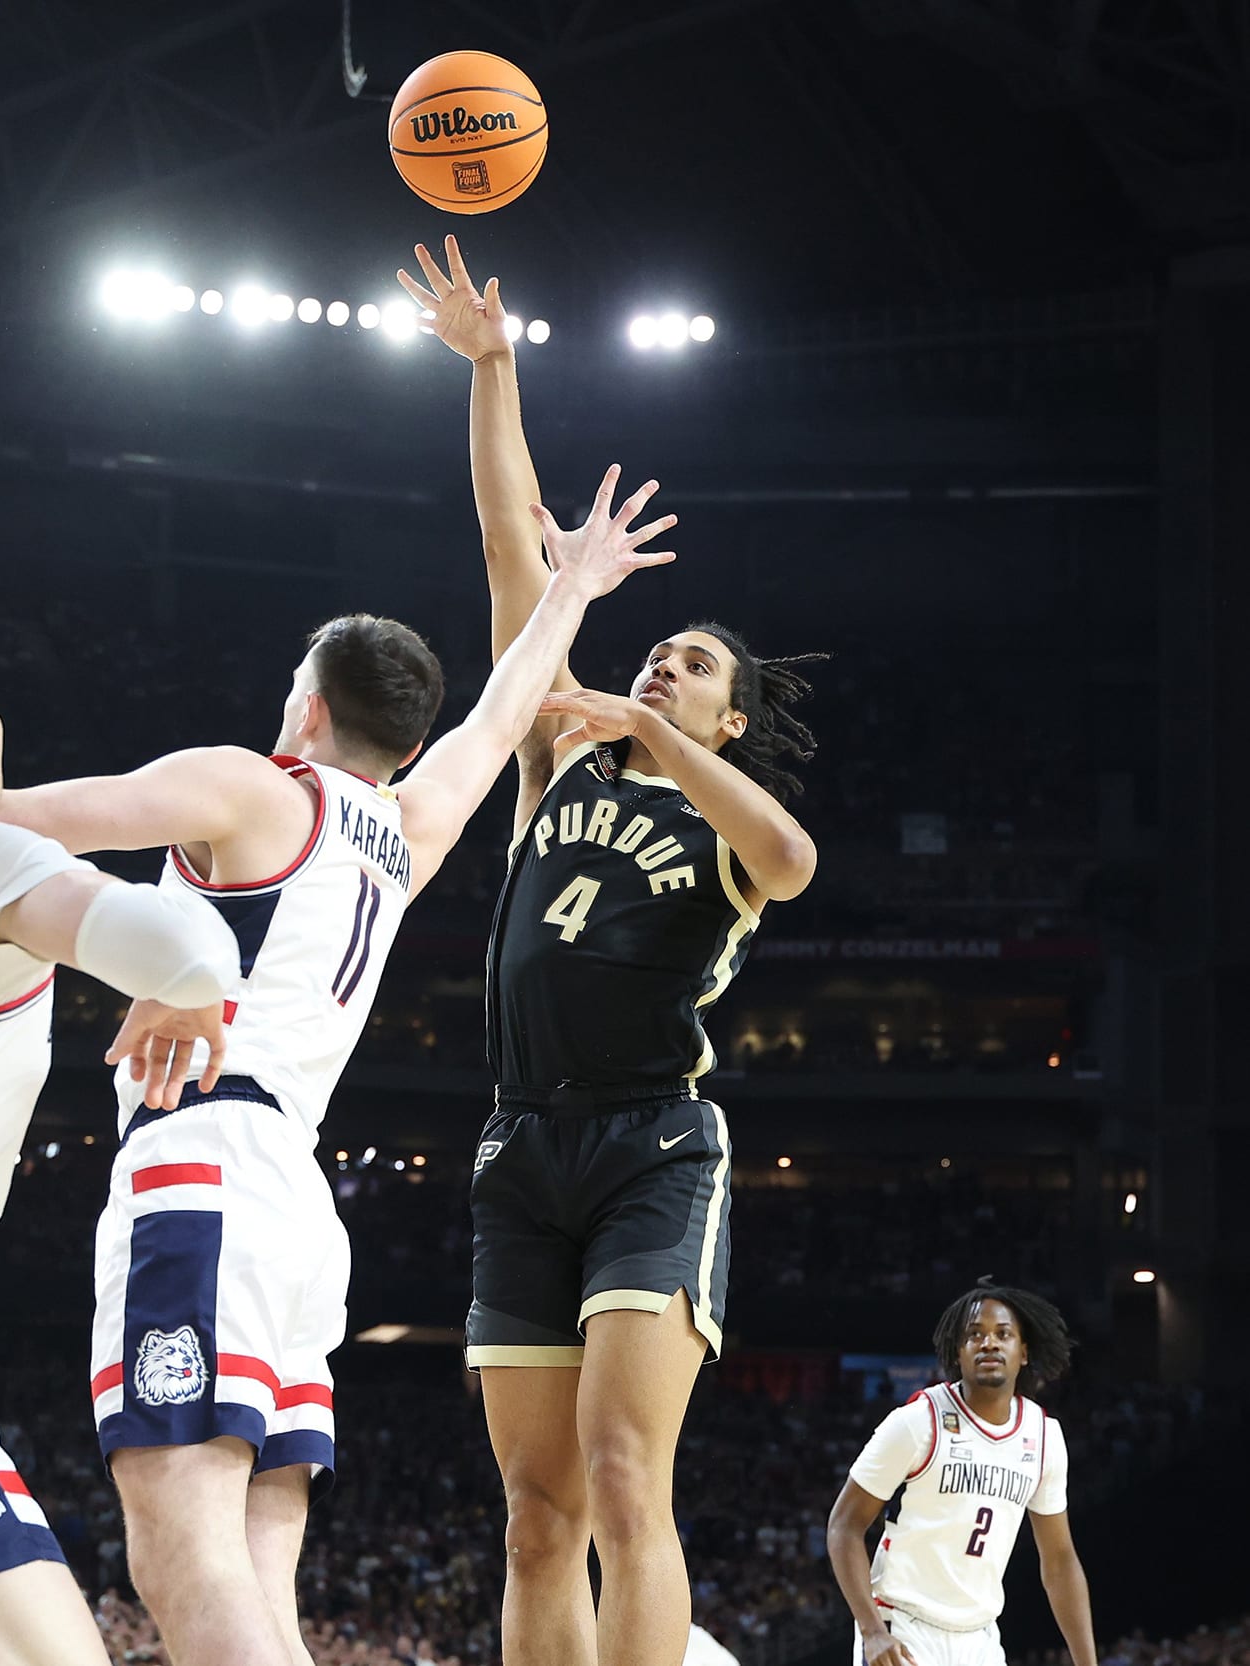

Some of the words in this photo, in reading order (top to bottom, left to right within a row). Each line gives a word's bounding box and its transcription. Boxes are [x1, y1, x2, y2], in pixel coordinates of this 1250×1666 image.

[411, 107, 517, 142] Wilson
[468, 134, 483, 142] NXT
[458, 166, 481, 178] FINAL
[459, 175, 482, 186] FOUR
[534, 799, 696, 896] PURDUE
[542, 875, 602, 943] 4
[331, 866, 381, 1008] 11
[939, 1462, 1033, 1508] CONNECTICUT
[965, 1507, 994, 1558] 2
